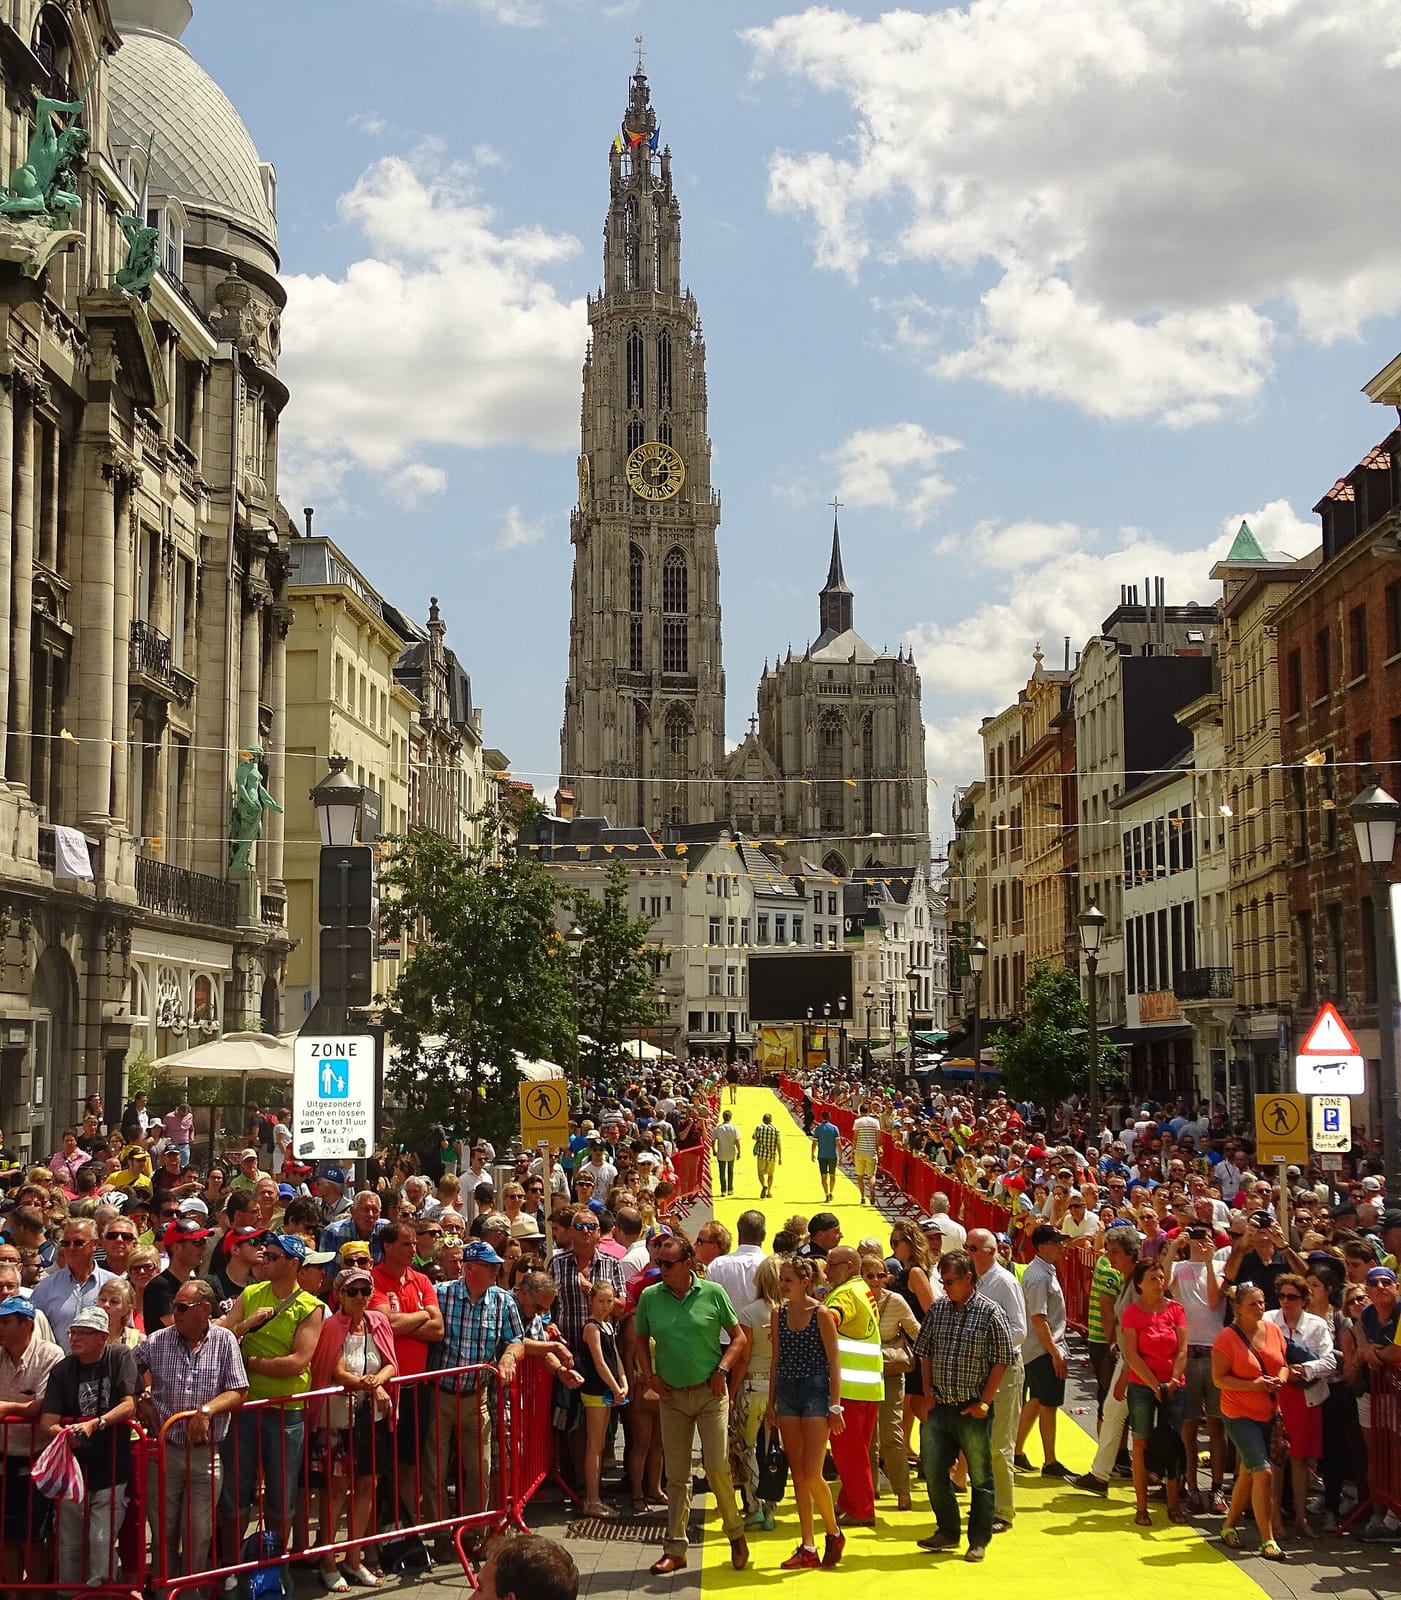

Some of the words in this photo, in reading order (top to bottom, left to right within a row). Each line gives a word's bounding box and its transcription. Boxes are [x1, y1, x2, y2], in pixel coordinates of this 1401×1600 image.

[311, 1043, 358, 1057] ZONE
[306, 1100, 362, 1109] Uitgezonderd
[1319, 1097, 1342, 1106] ZONE
[302, 1109, 325, 1117] laden
[338, 1109, 366, 1117] lossen
[1327, 1109, 1337, 1122] P
[317, 1118, 322, 1126] 7
[331, 1118, 344, 1126] tot
[345, 1118, 352, 1126] 11
